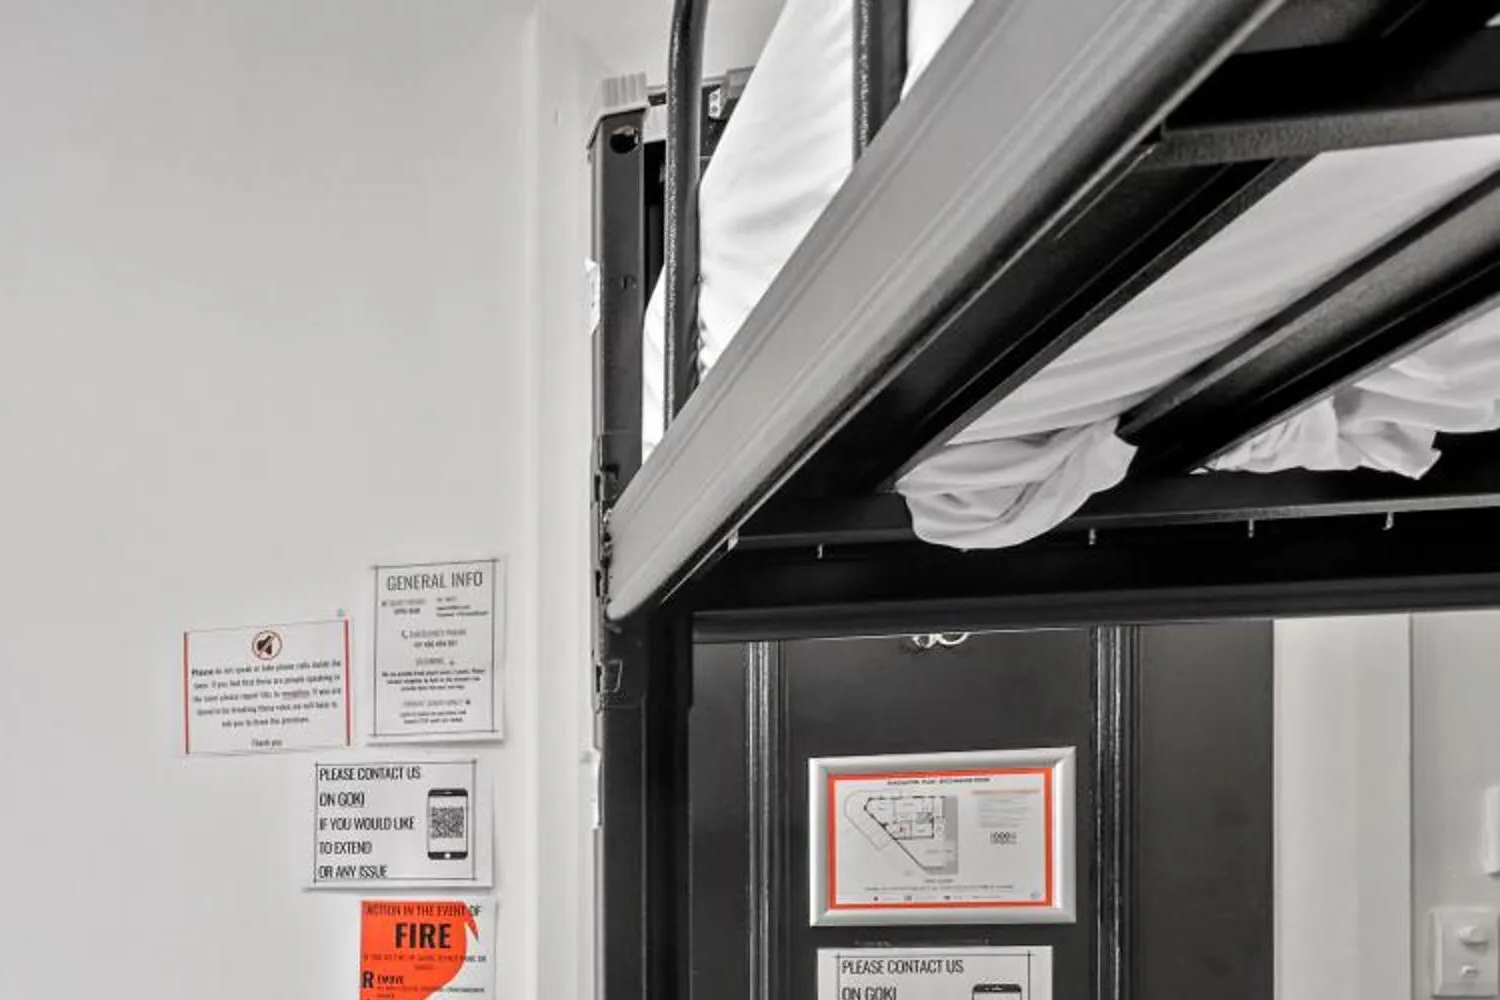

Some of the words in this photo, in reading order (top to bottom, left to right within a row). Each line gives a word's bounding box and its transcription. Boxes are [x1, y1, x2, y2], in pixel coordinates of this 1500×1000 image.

[387, 573, 447, 591] GENERAL
[452, 571, 483, 588] INFO
[320, 767, 356, 781] PLEASE
[357, 767, 403, 781] CONTACT
[406, 766, 421, 780] US
[320, 792, 335, 807] ON
[338, 791, 365, 808] GOKI
[320, 817, 328, 831] IF
[330, 817, 352, 831] YOU
[354, 817, 392, 831] WOULD
[393, 816, 415, 830] LIKE
[319, 841, 333, 855] TO
[334, 841, 373, 855] EXTEND
[319, 865, 333, 879] OR
[336, 865, 357, 879] ANY
[359, 865, 388, 879] ISSUE
[403, 905, 415, 917] IN
[417, 905, 435, 917] THE
[438, 905, 465, 917] EVENT
[395, 922, 453, 949] FIRE
[842, 959, 885, 975] PLEASE
[887, 959, 943, 975] CONTACT
[945, 959, 965, 974] US
[363, 970, 375, 988] R
